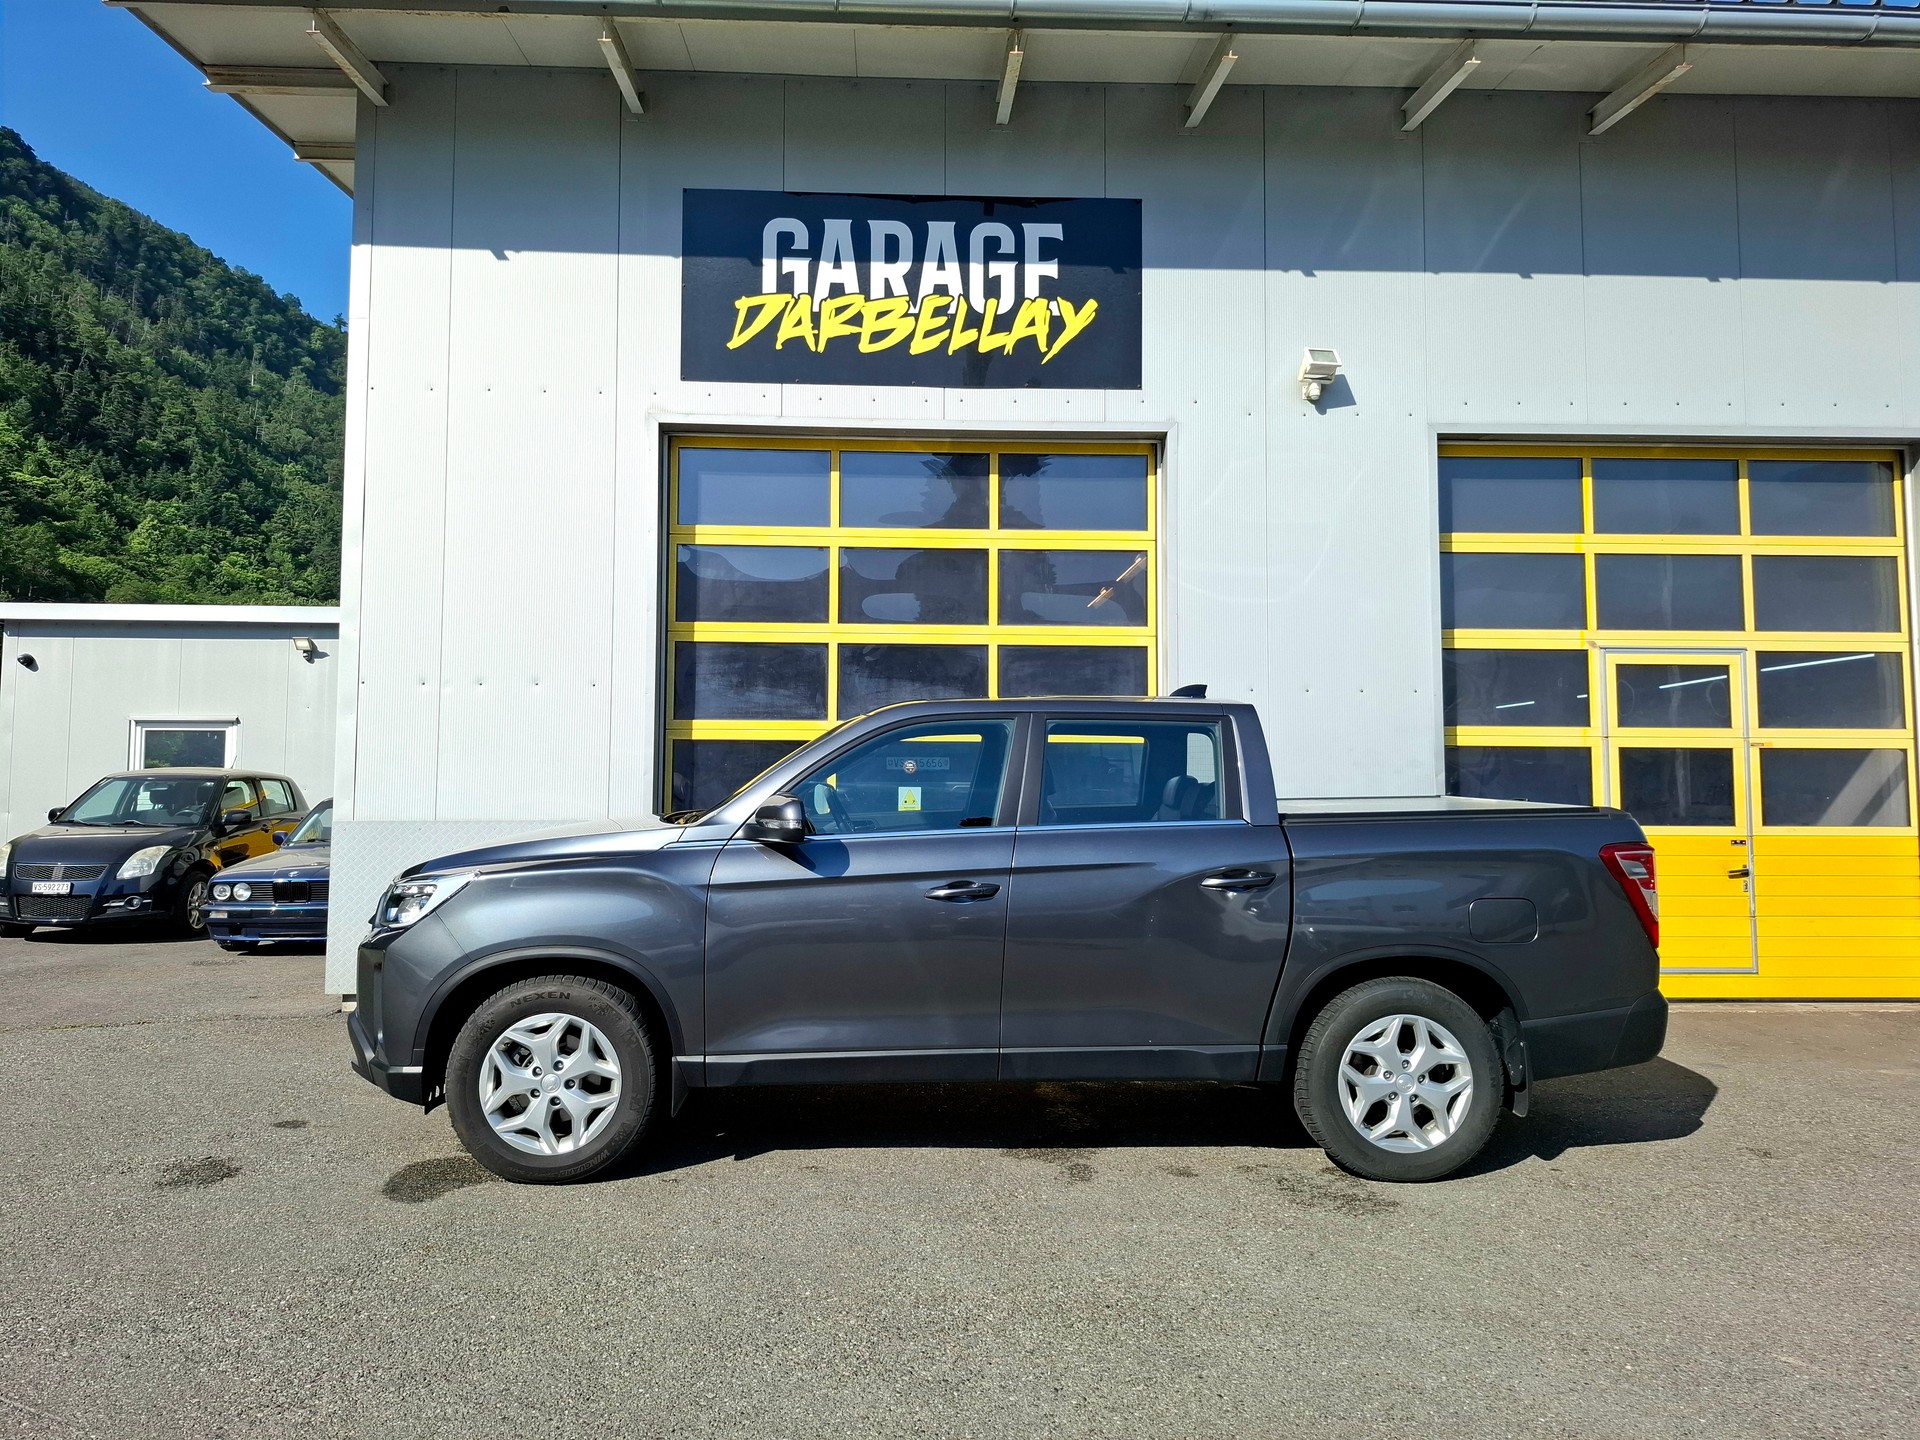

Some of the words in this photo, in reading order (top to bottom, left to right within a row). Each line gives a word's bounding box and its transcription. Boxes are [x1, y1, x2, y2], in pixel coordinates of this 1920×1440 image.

[762, 217, 1064, 316] GARAGE
[726, 293, 1099, 365] DARBELLAY
[510, 991, 571, 1008] NEXEN
